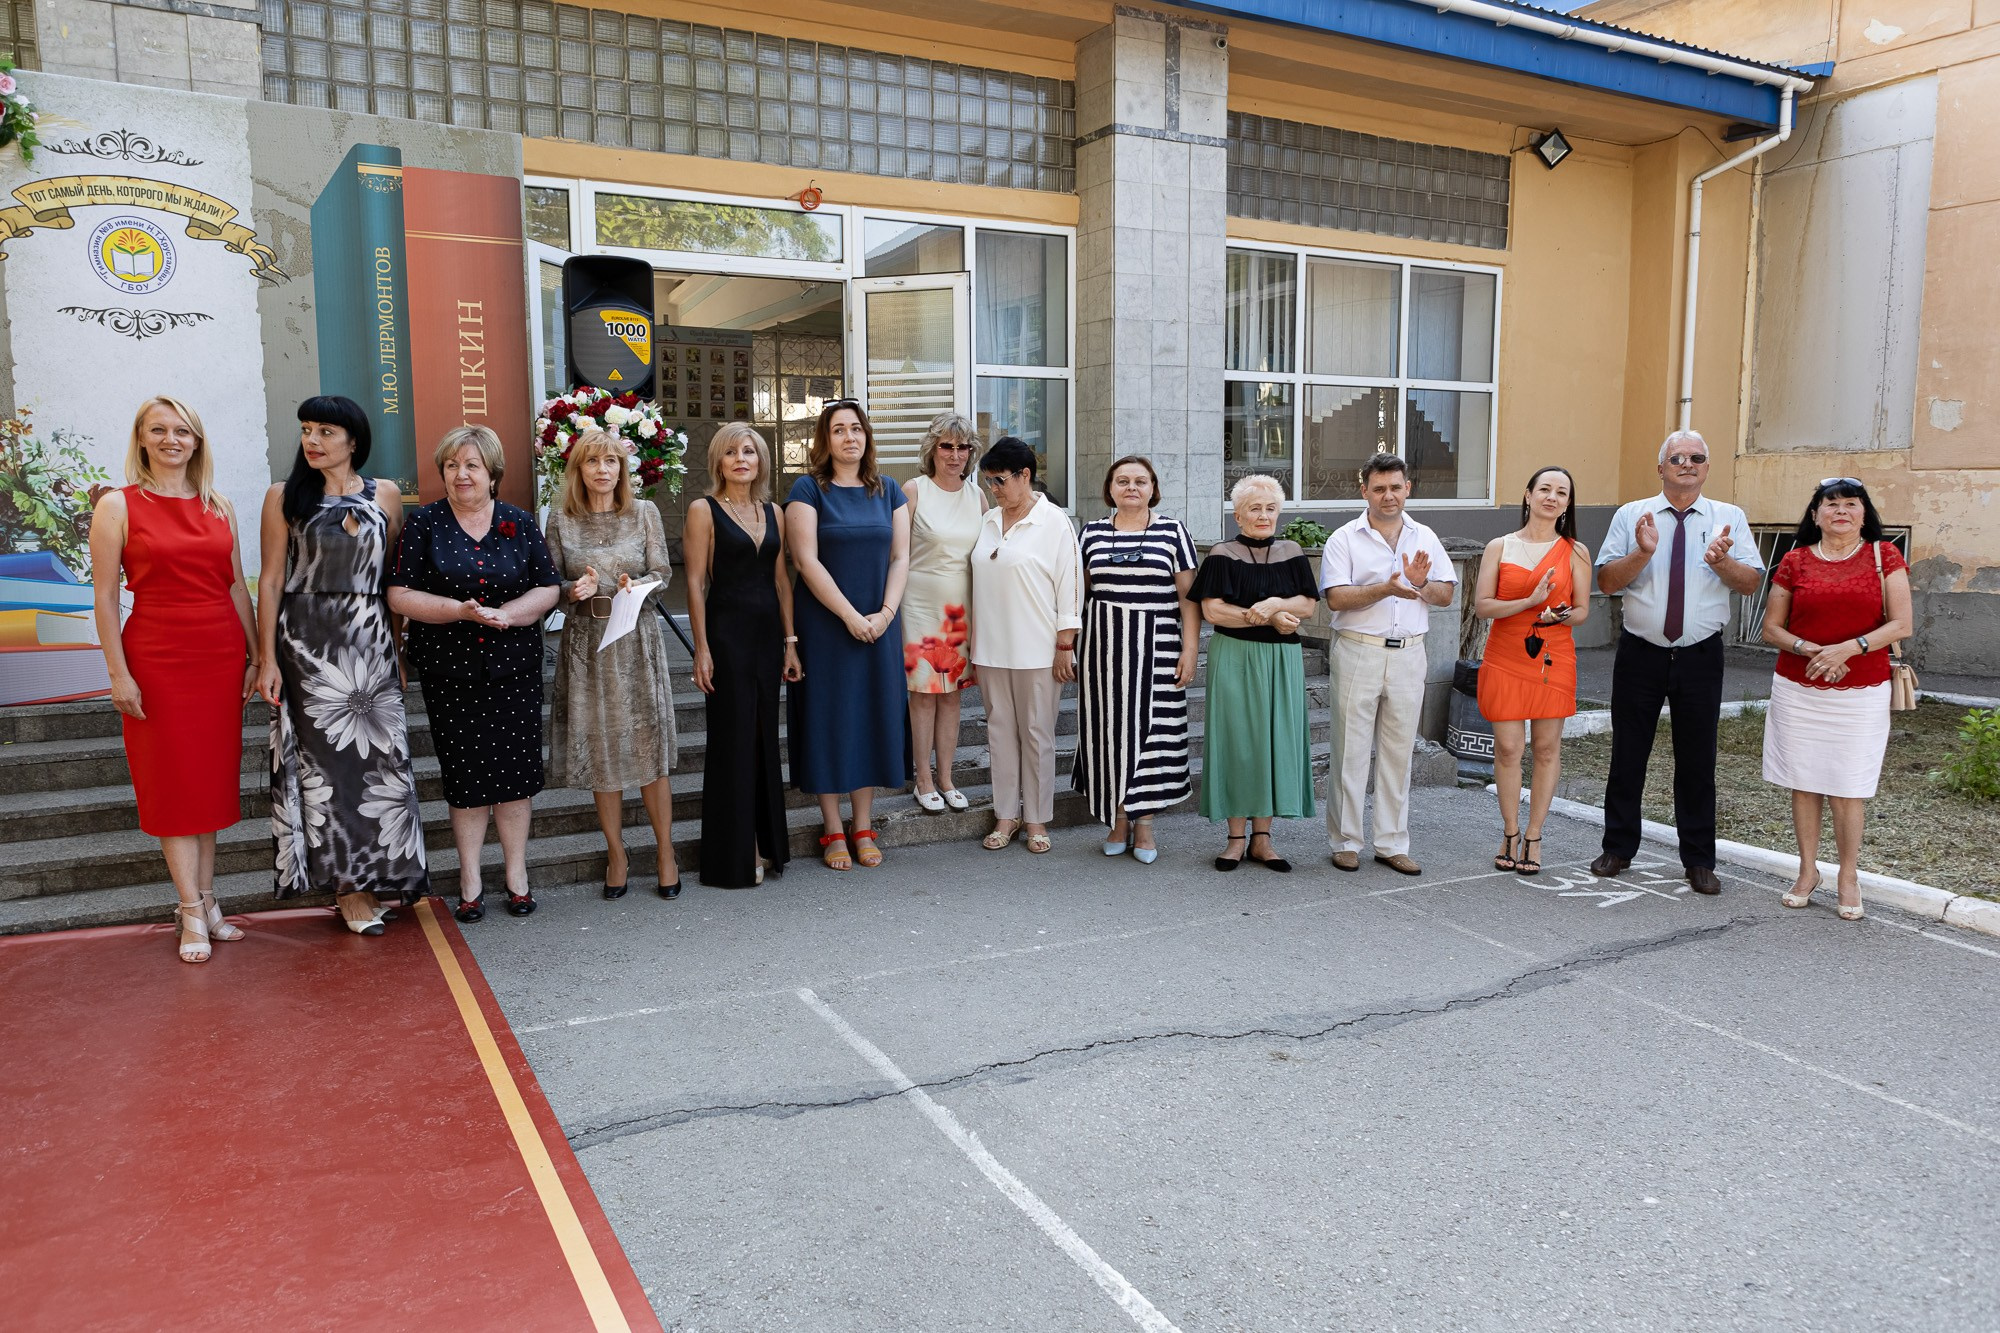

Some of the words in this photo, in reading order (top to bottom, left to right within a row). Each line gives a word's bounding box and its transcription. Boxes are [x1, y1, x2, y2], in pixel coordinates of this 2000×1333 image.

[27, 190, 47, 204] ТОТ
[48, 183, 85, 199] САМЫЙ
[86, 185, 115, 198] ДЕНЬ,
[117, 186, 163, 201] КОТОРОГО
[165, 193, 181, 205] МЫ
[98, 222, 114, 236] №8
[114, 219, 145, 229] имени
[120, 281, 149, 292] ГБОУ
[605, 322, 646, 337] 1000
[457, 299, 488, 428] ШКИН
